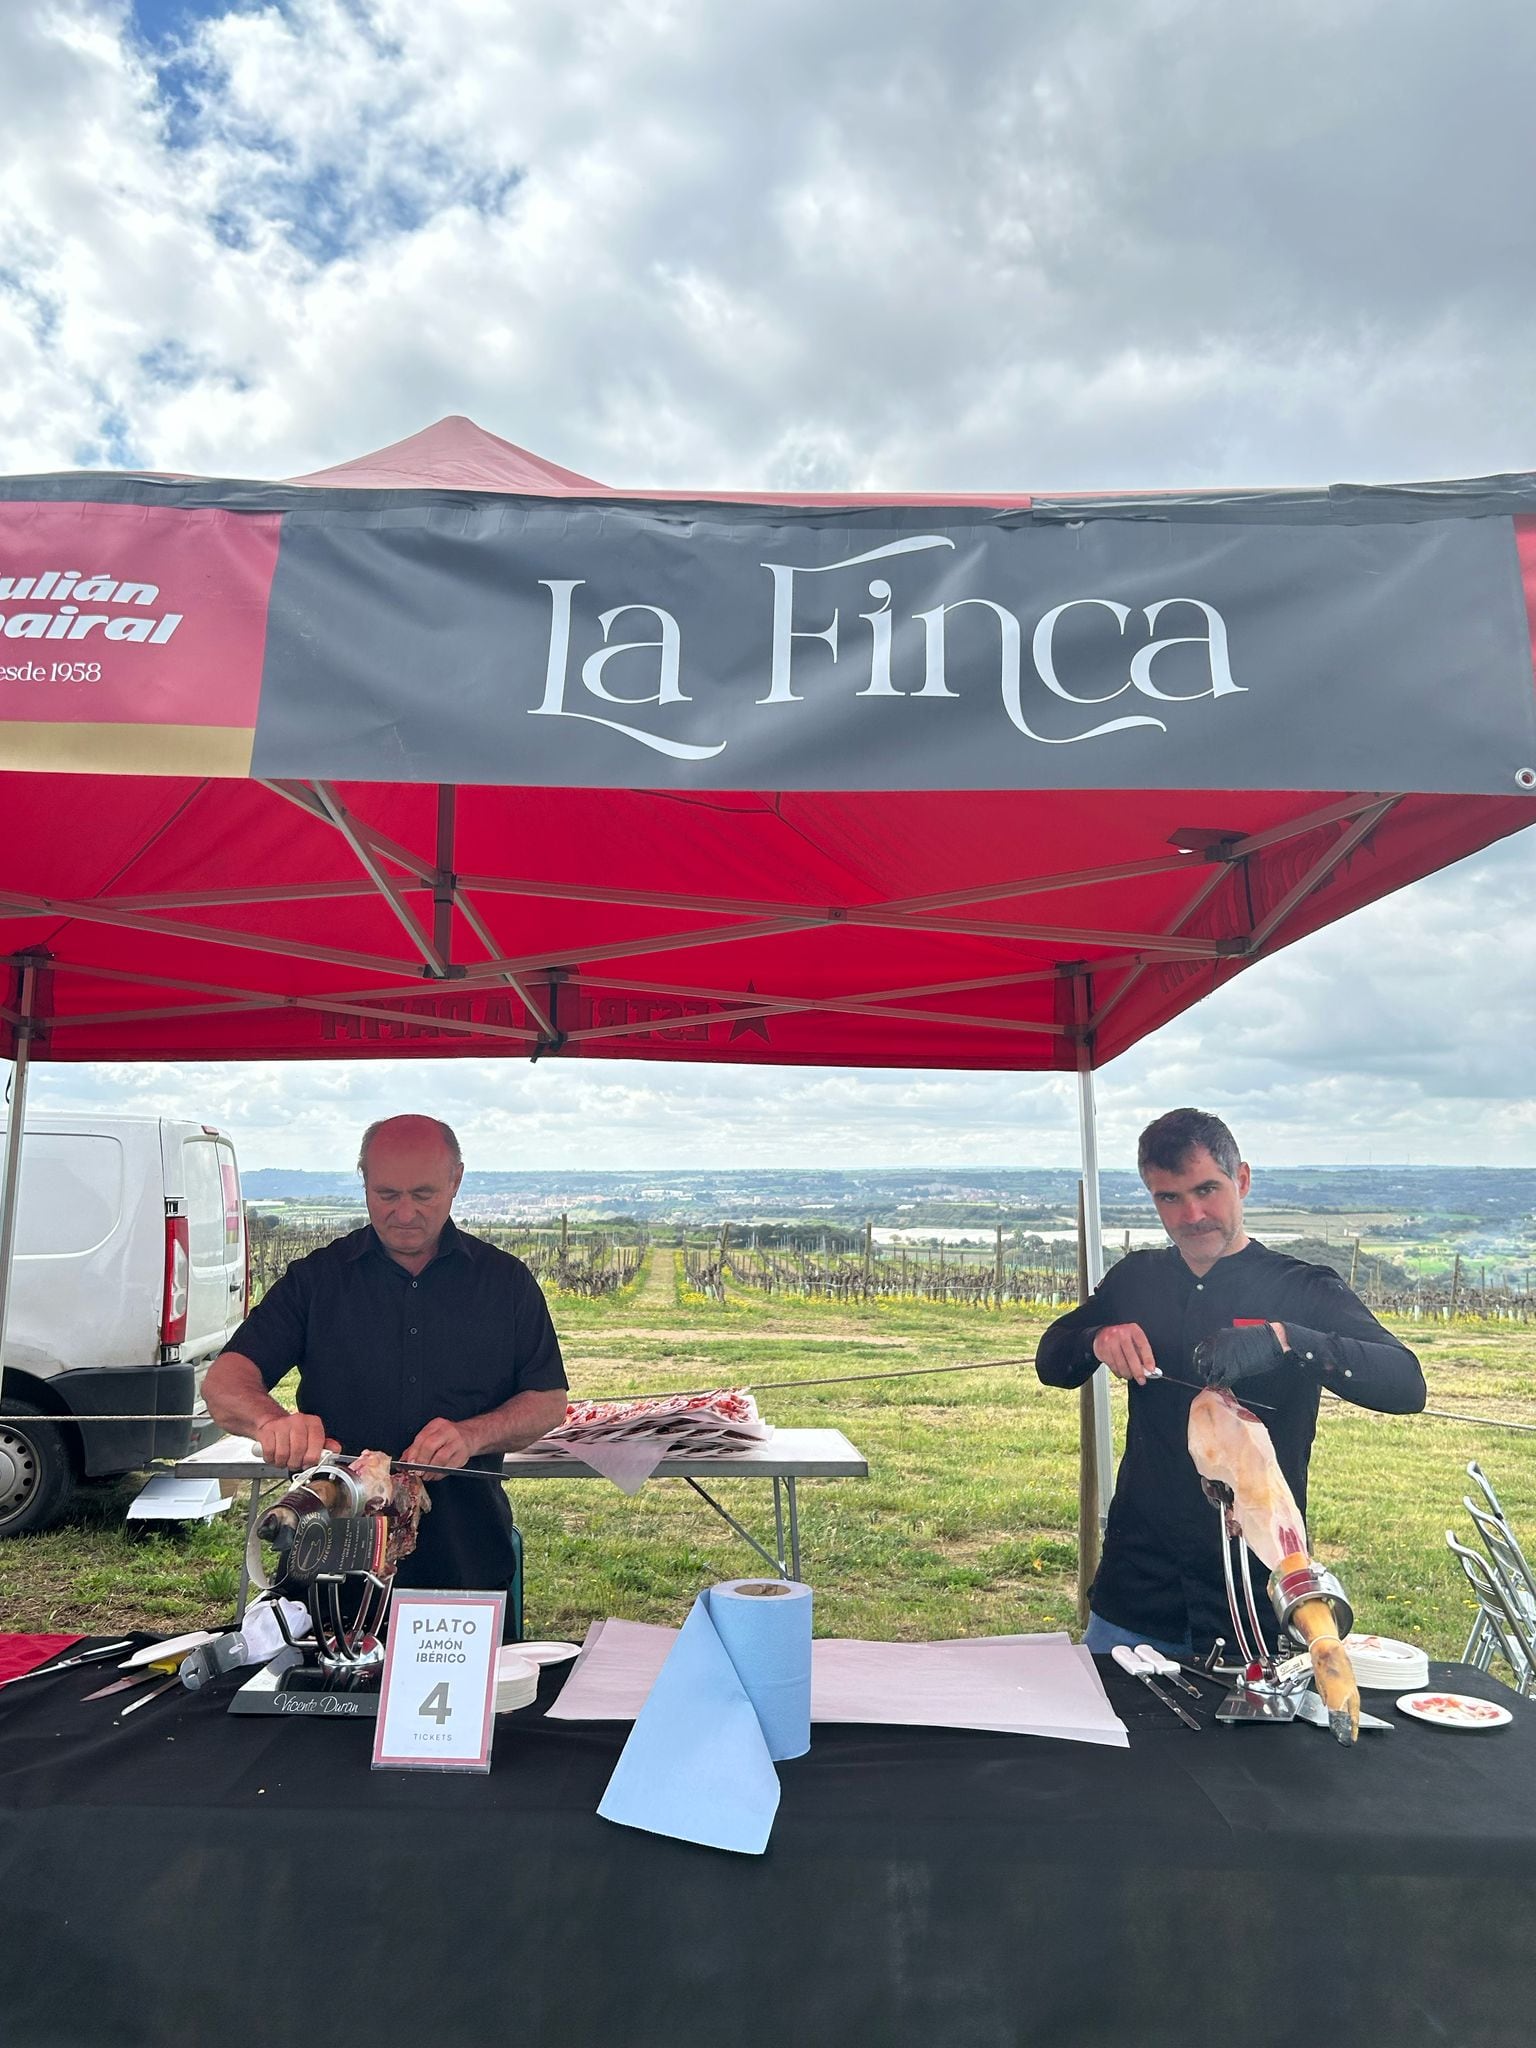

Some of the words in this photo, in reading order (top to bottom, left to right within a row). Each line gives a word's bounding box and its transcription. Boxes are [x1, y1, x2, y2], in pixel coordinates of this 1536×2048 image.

[0, 571, 160, 606] ulián
[0, 605, 183, 644] airal
[527, 579, 727, 760] La
[755, 535, 1249, 744] Finca
[50, 662, 102, 683] 1958
[412, 1618, 477, 1635] PLATO
[418, 1638, 463, 1650] JAMÓN
[416, 1651, 467, 1664] IBÉRICO
[274, 1693, 318, 1713] Vicente
[418, 1682, 453, 1725] 4
[413, 1733, 453, 1742] TICKETS
